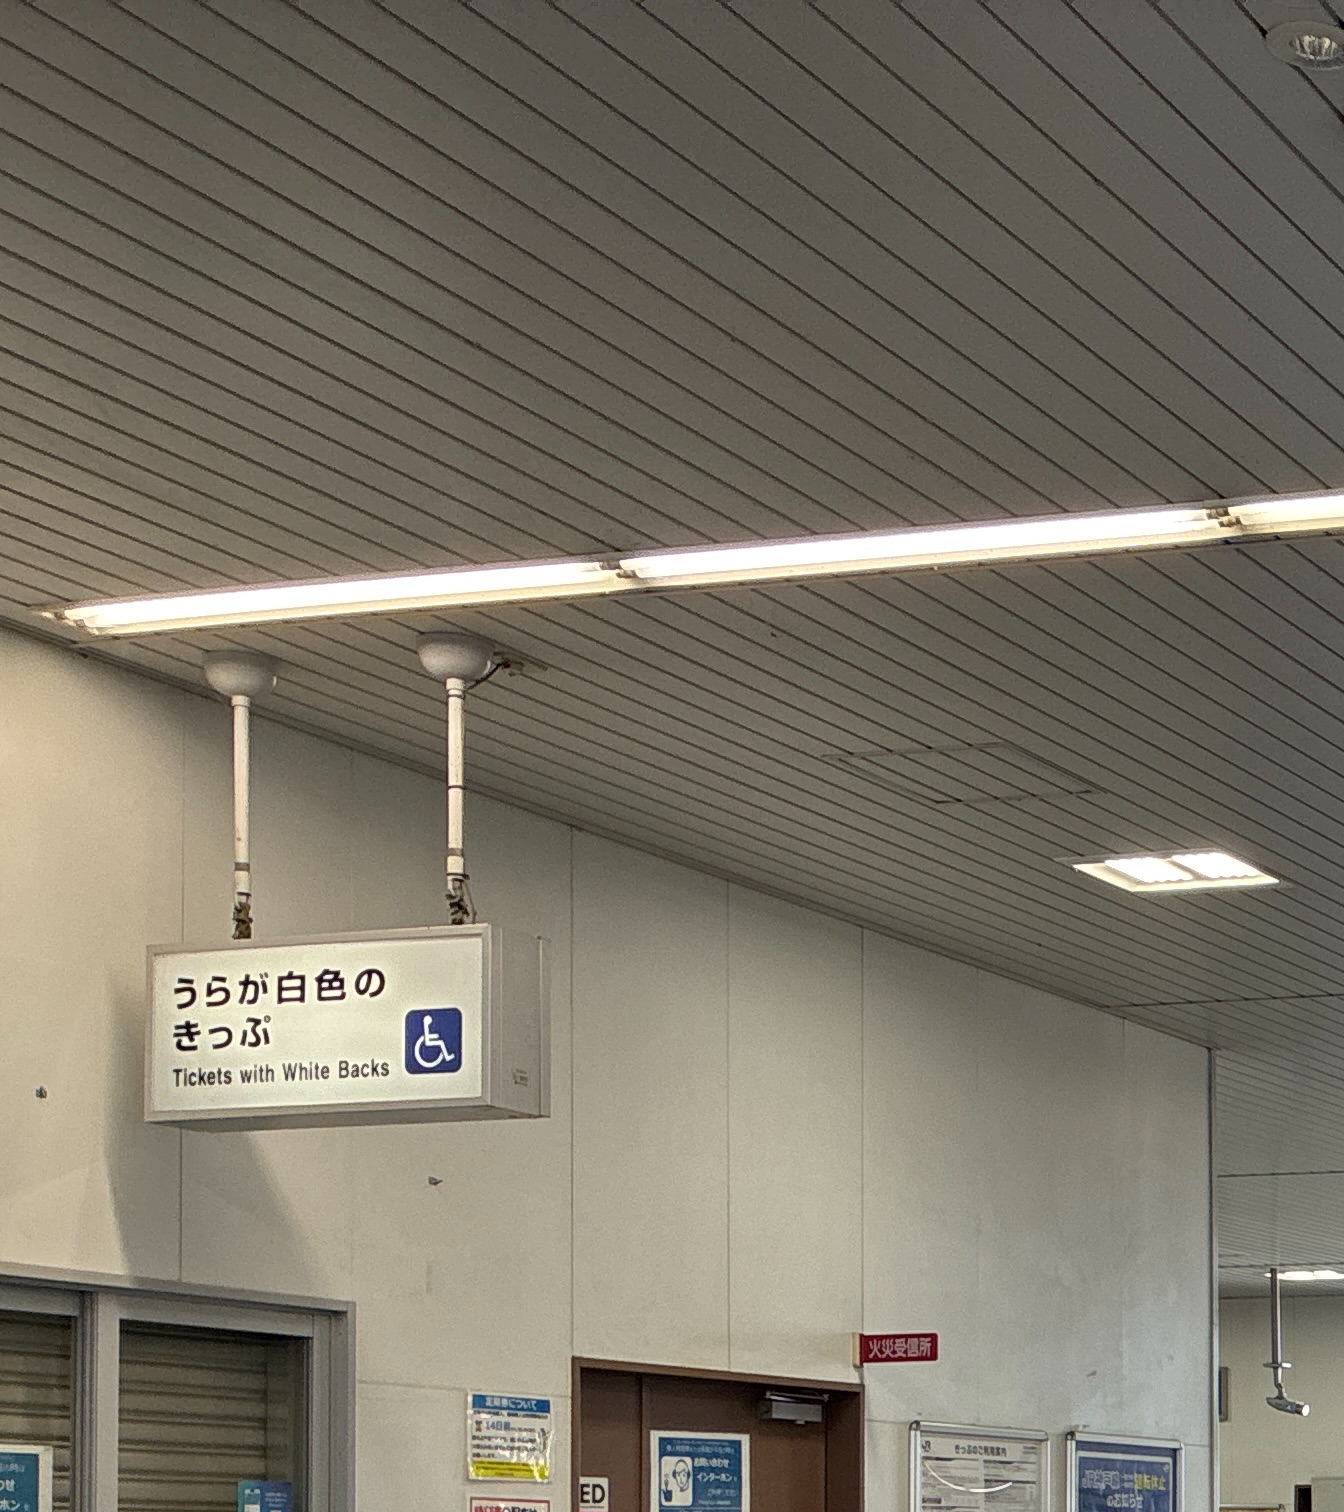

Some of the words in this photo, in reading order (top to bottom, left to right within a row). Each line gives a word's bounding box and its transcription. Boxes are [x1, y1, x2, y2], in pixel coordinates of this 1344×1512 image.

[173, 968, 386, 1010] うらが白色の
[173, 1015, 272, 1052] きっぷ
[173, 1065, 232, 1087] Tickets
[240, 1063, 275, 1083] with
[282, 1060, 330, 1082] White
[339, 1058, 389, 1078] Backs
